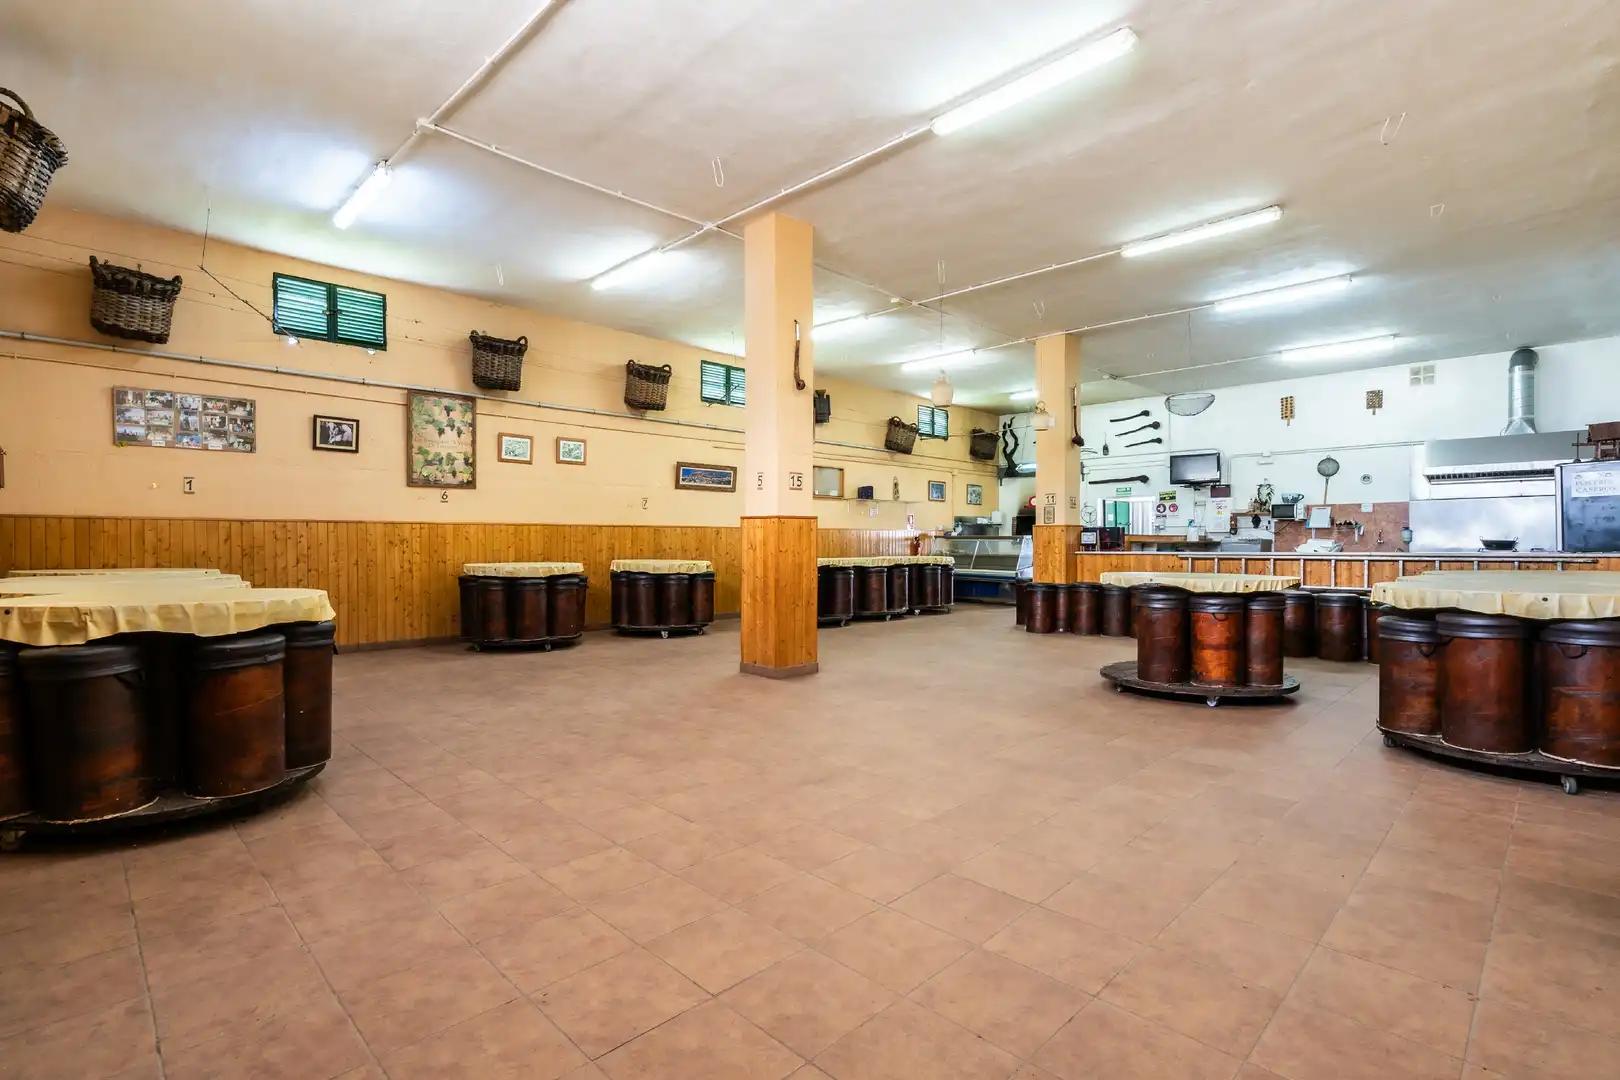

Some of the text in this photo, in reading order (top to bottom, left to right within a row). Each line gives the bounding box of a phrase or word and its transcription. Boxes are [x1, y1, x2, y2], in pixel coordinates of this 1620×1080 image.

[186, 480, 192, 490] 1
[757, 475, 763, 487] 5
[790, 475, 803, 487] 15
[441, 491, 448, 500] 6
[1045, 494, 1055, 503] 11
